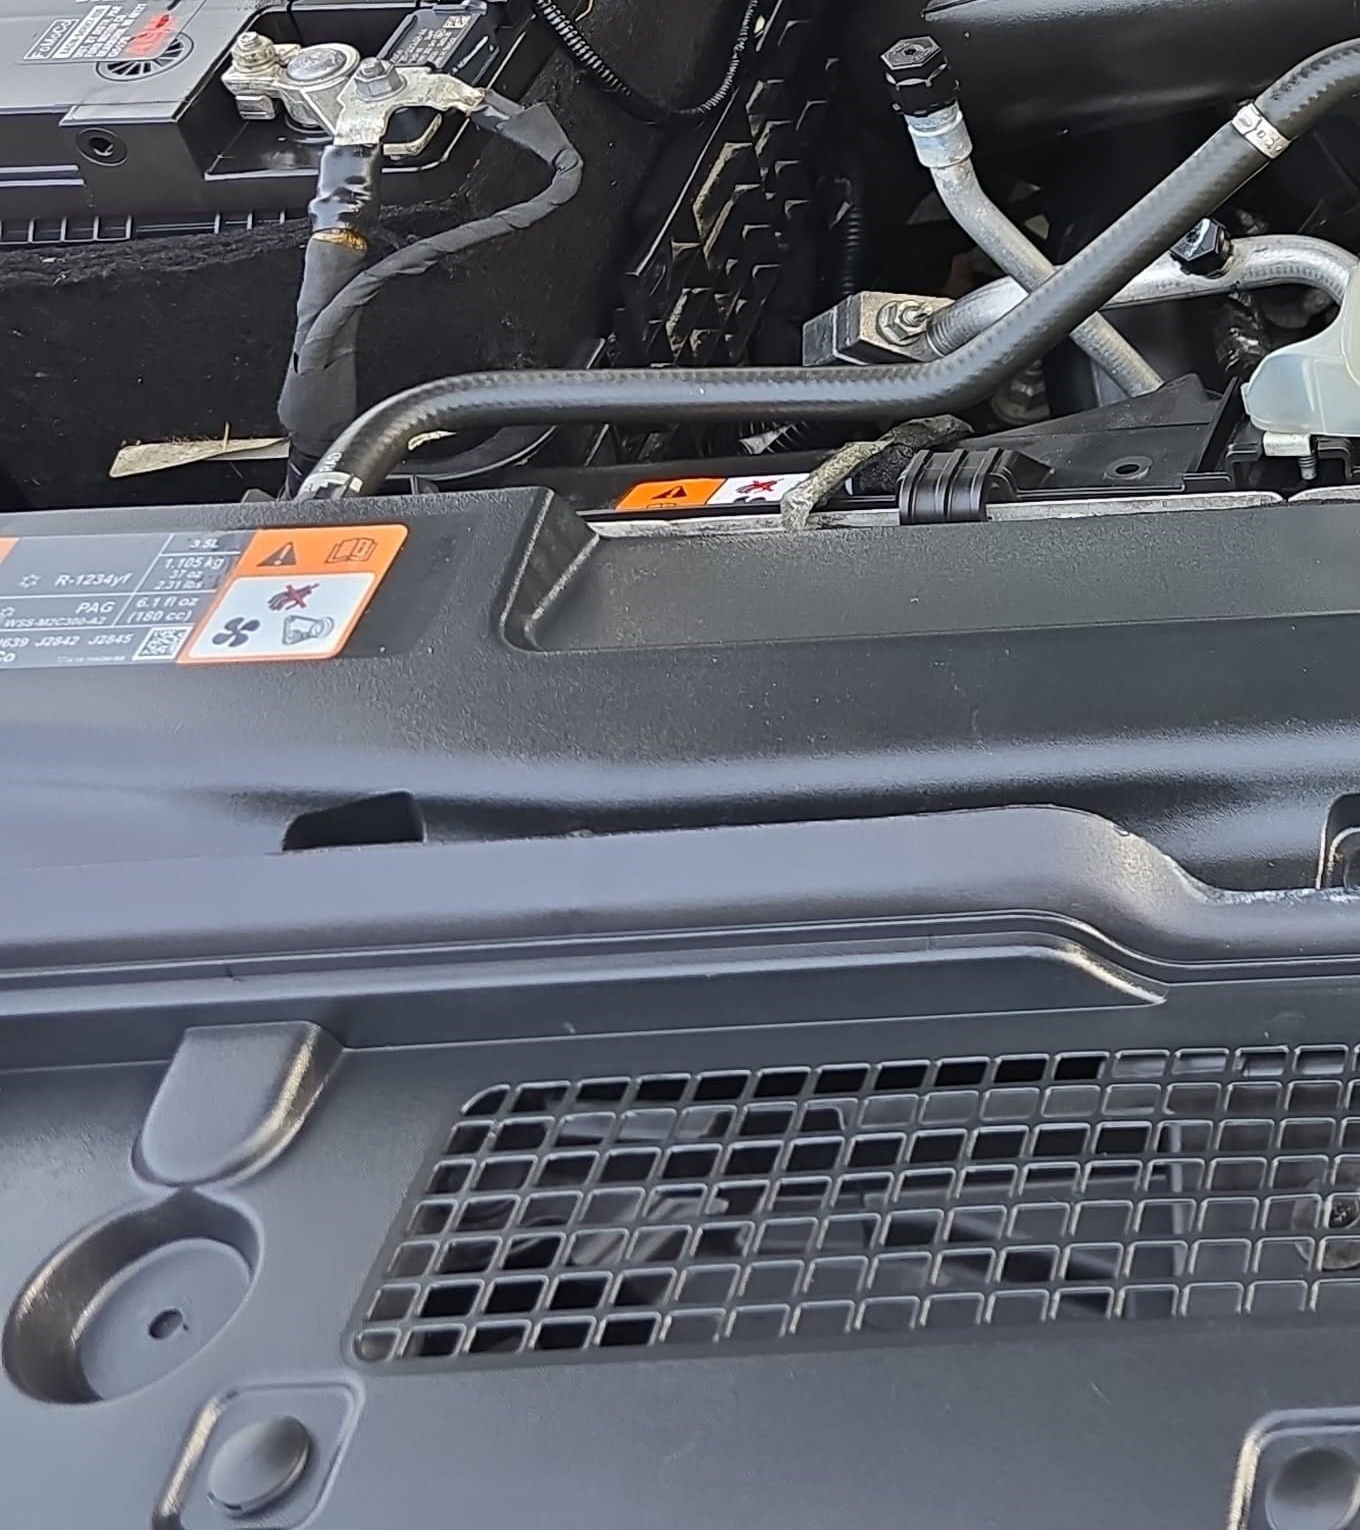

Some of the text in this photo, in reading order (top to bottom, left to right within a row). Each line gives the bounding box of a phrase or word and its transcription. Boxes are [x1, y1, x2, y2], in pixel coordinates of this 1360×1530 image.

[164, 556, 225, 570] 1.105 kg
[53, 571, 133, 589] R-1234yf
[75, 601, 116, 614] PAG
[136, 596, 161, 608] 6.1
[178, 597, 200, 607] oz
[127, 609, 193, 624] (180 cc)
[34, 635, 81, 647] J2842
[88, 633, 134, 646] J2845
